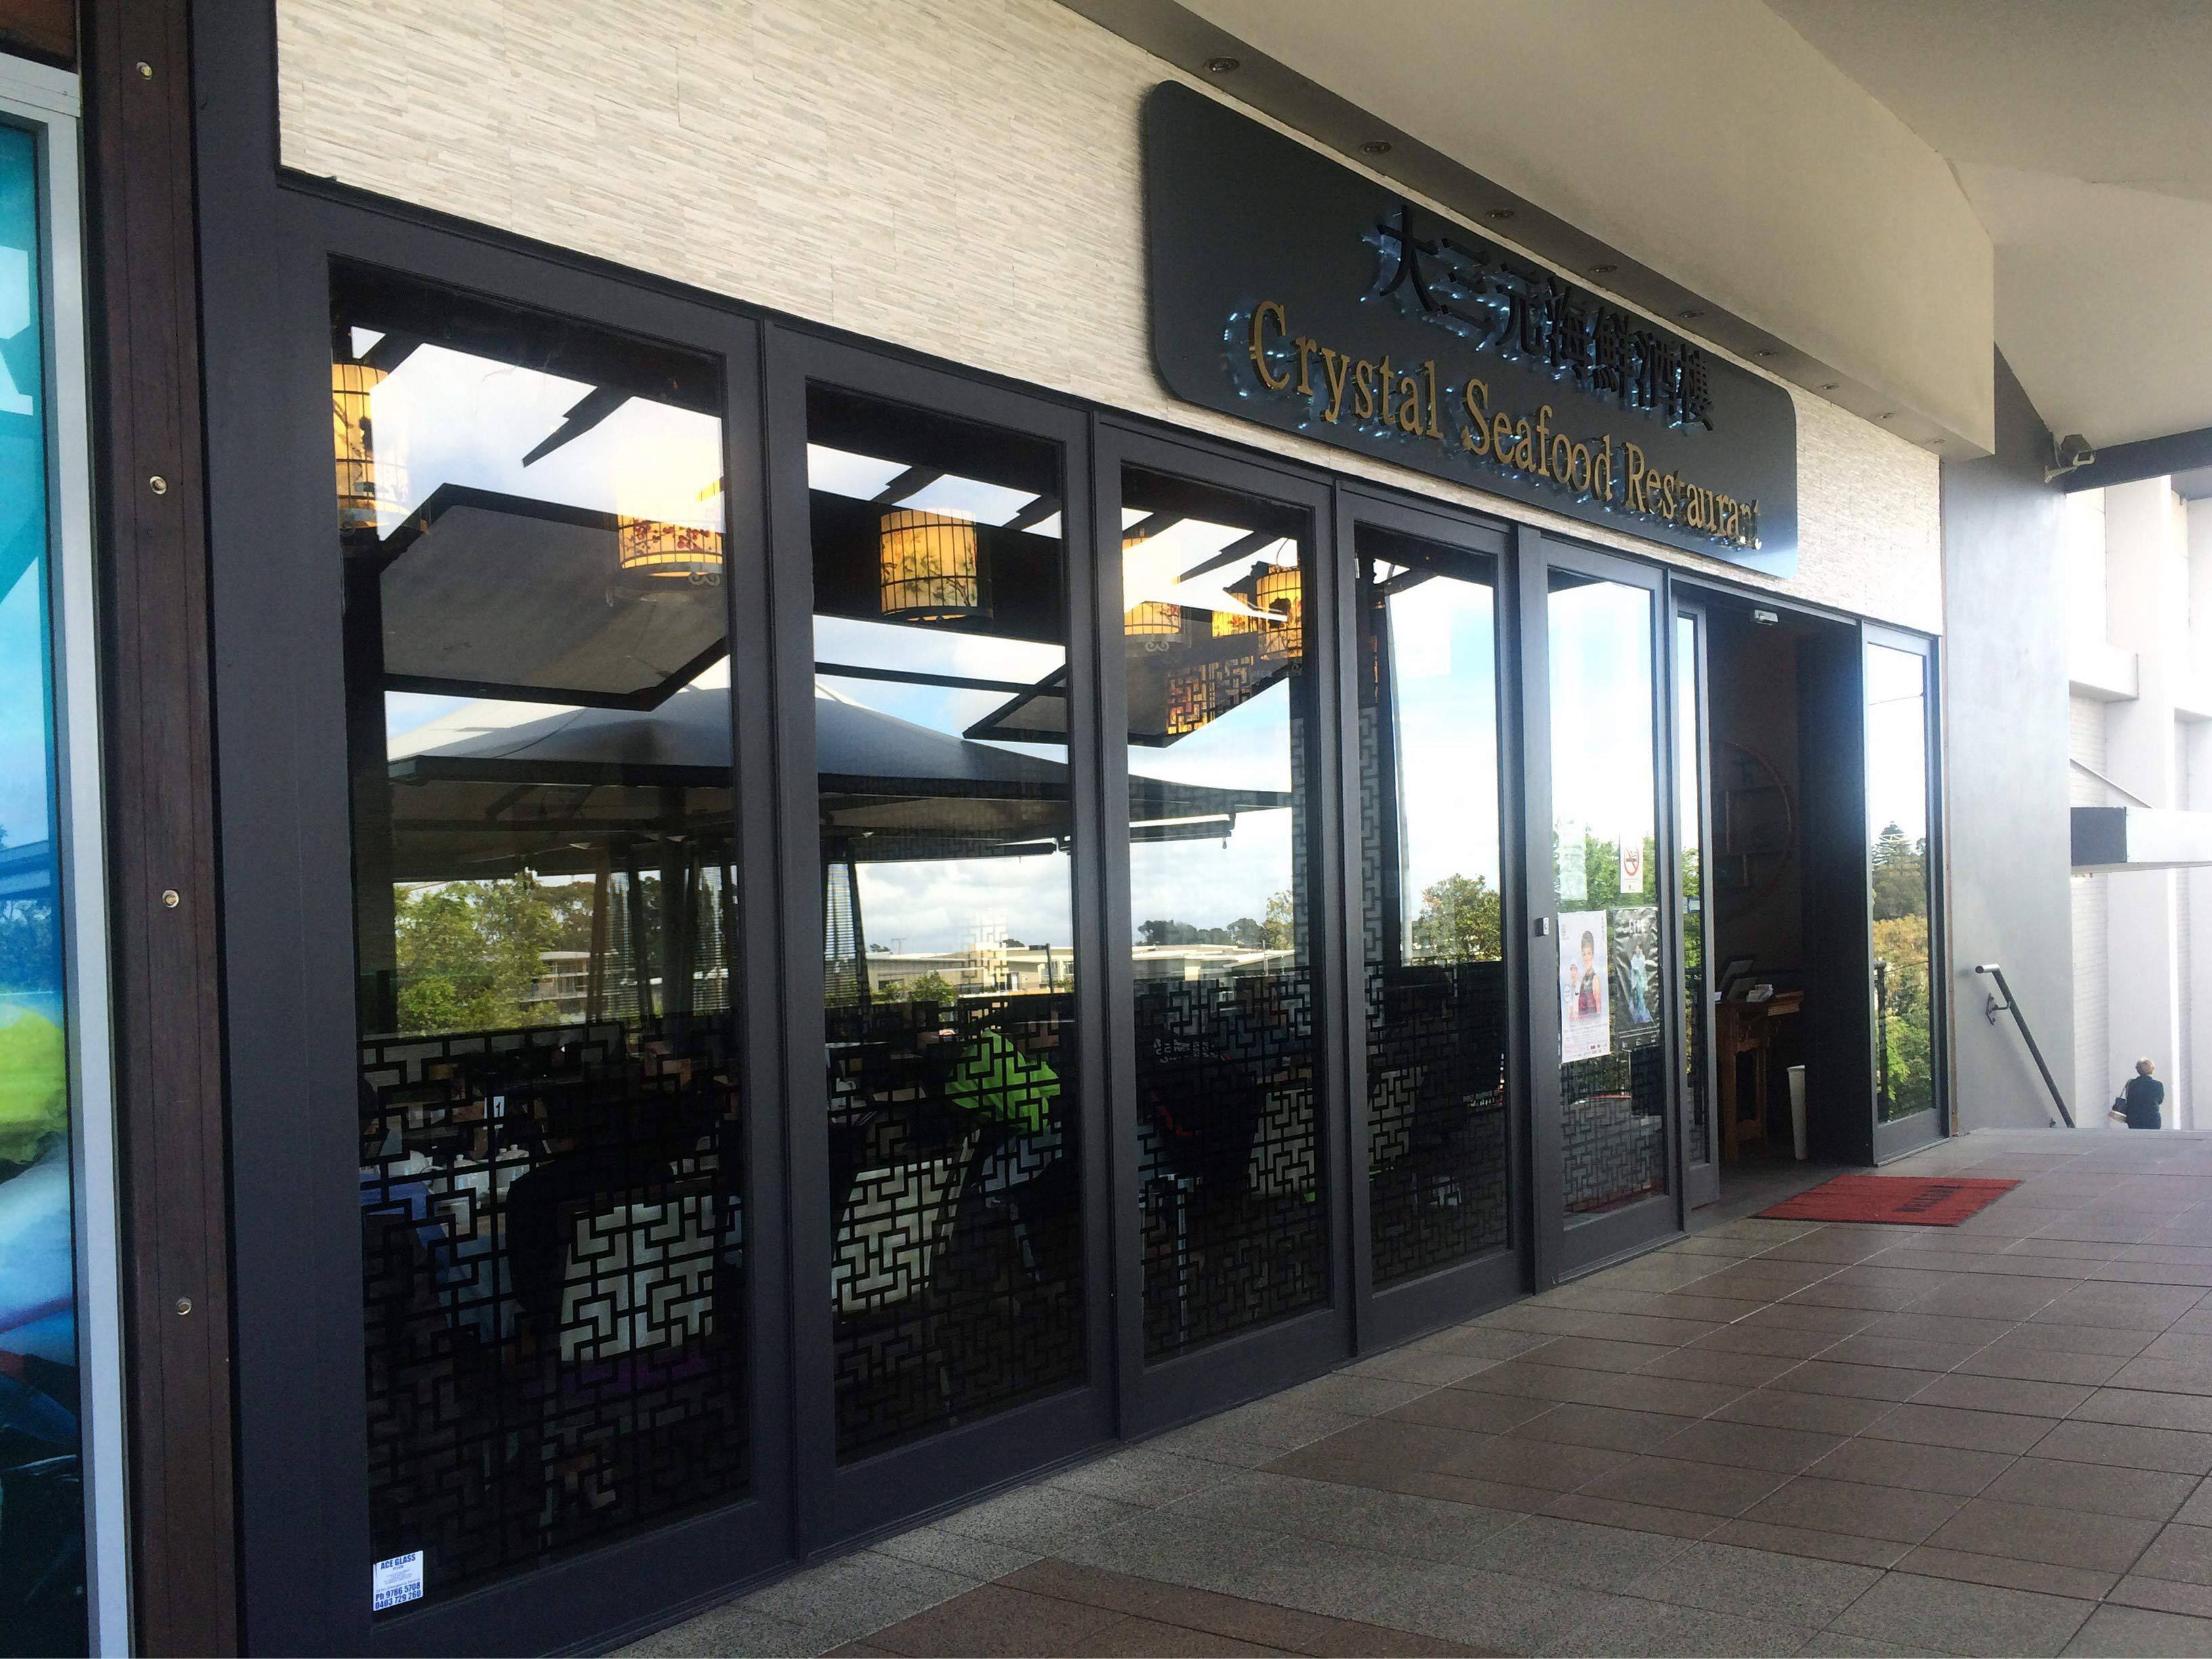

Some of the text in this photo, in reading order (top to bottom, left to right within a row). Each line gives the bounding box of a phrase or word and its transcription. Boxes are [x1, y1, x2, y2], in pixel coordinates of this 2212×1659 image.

[1376, 204, 1714, 432] 大三元海鮮酒樓
[1248, 300, 1762, 550] Crystal Seafood Restaurant
[380, 1559, 393, 1570] ACE
[394, 1553, 415, 1565] GLASS
[375, 1593, 384, 1602] Ph
[404, 1582, 421, 1593] 5708
[375, 1589, 422, 1609] 0403 729 260
